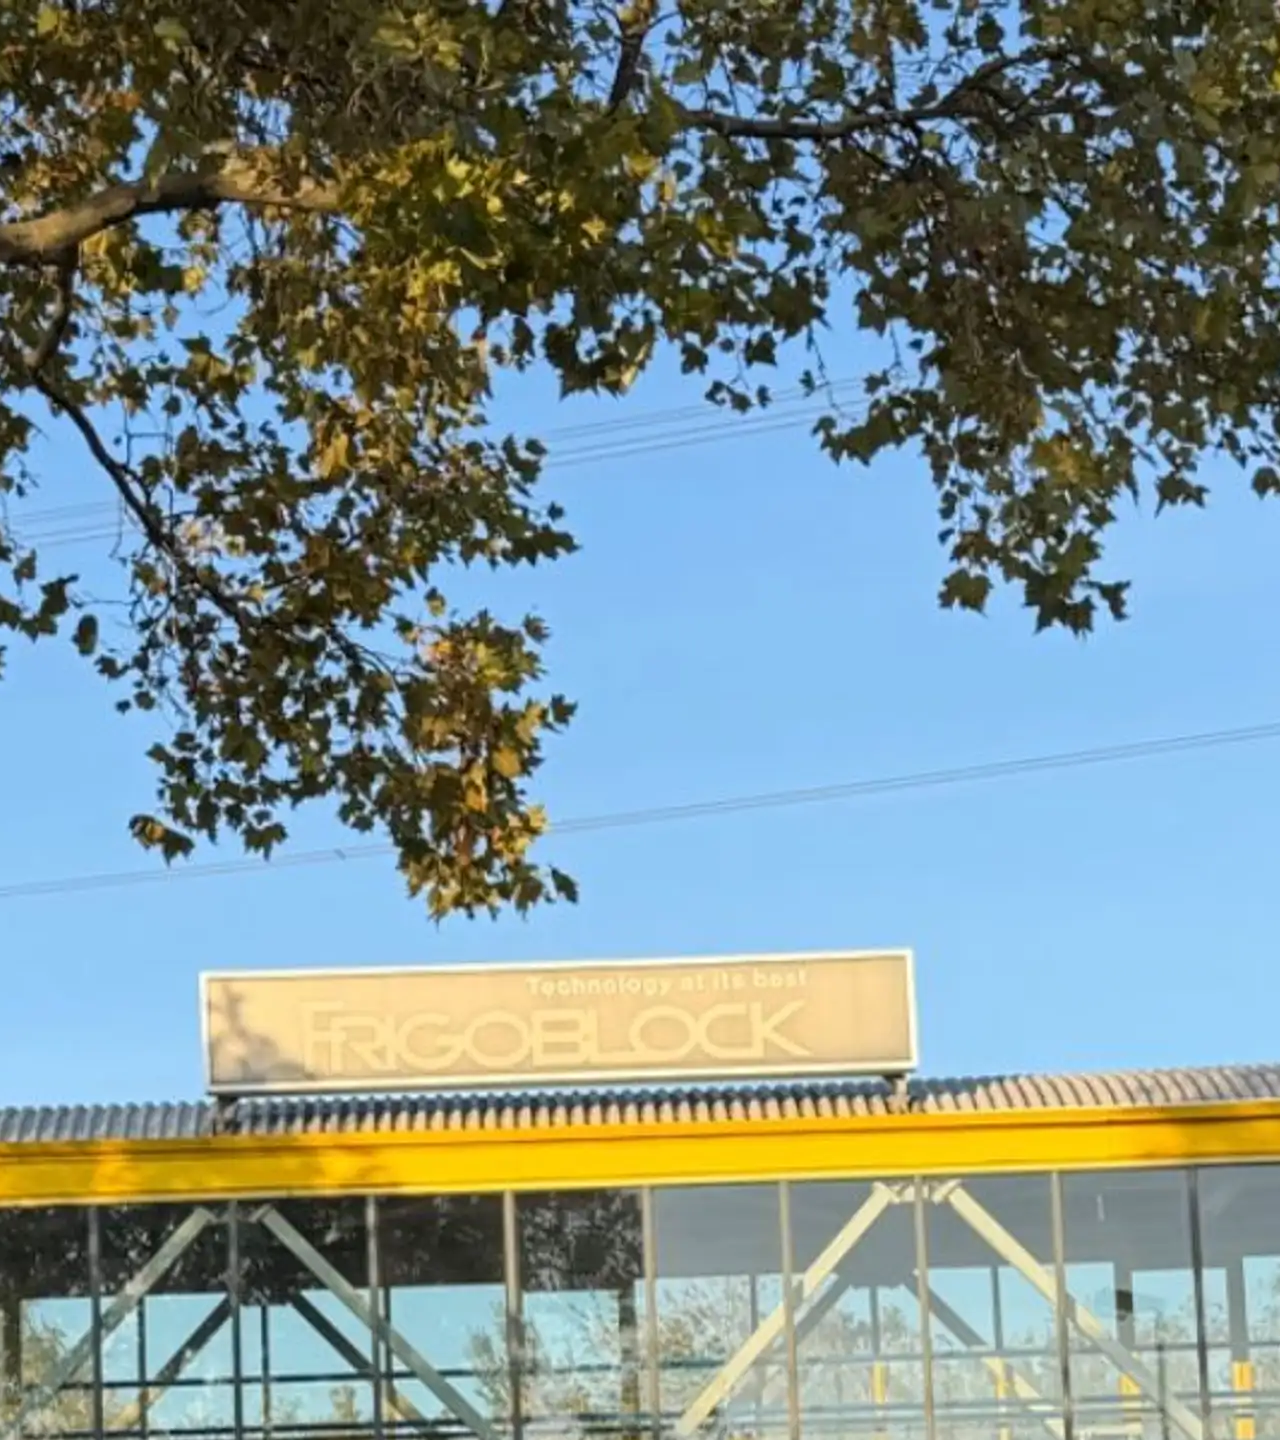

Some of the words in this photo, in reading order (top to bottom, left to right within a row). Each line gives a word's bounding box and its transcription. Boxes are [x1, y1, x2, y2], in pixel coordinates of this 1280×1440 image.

[525, 974, 671, 997] Technology
[680, 972, 705, 991] at
[712, 969, 746, 991] its
[752, 967, 808, 989] best
[298, 999, 815, 1076] FRIGOBLOCK
